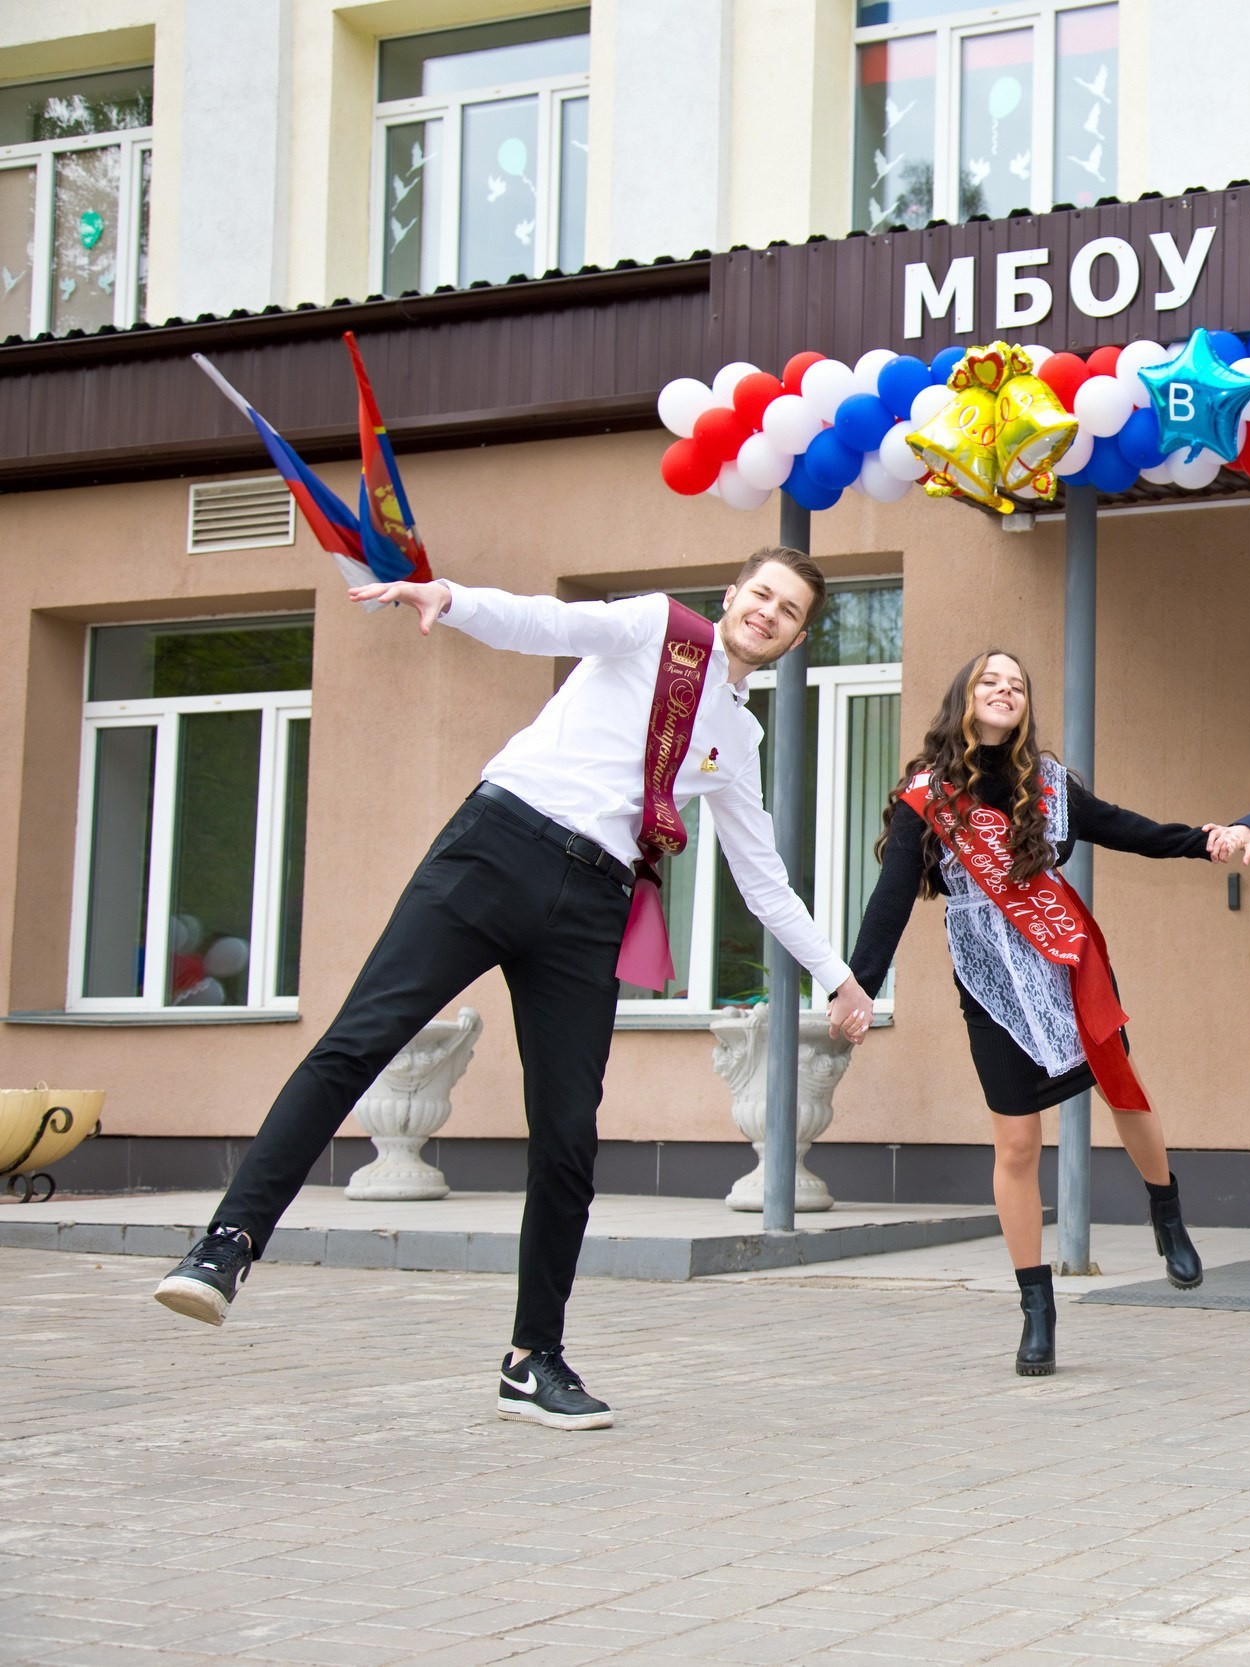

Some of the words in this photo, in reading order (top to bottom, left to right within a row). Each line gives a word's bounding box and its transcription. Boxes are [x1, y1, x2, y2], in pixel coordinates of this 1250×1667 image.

[903, 225, 1218, 340] МБОУ
[652, 677, 697, 793] Выпускник
[652, 792, 677, 832] 2021
[1027, 889, 1088, 943] 2021
